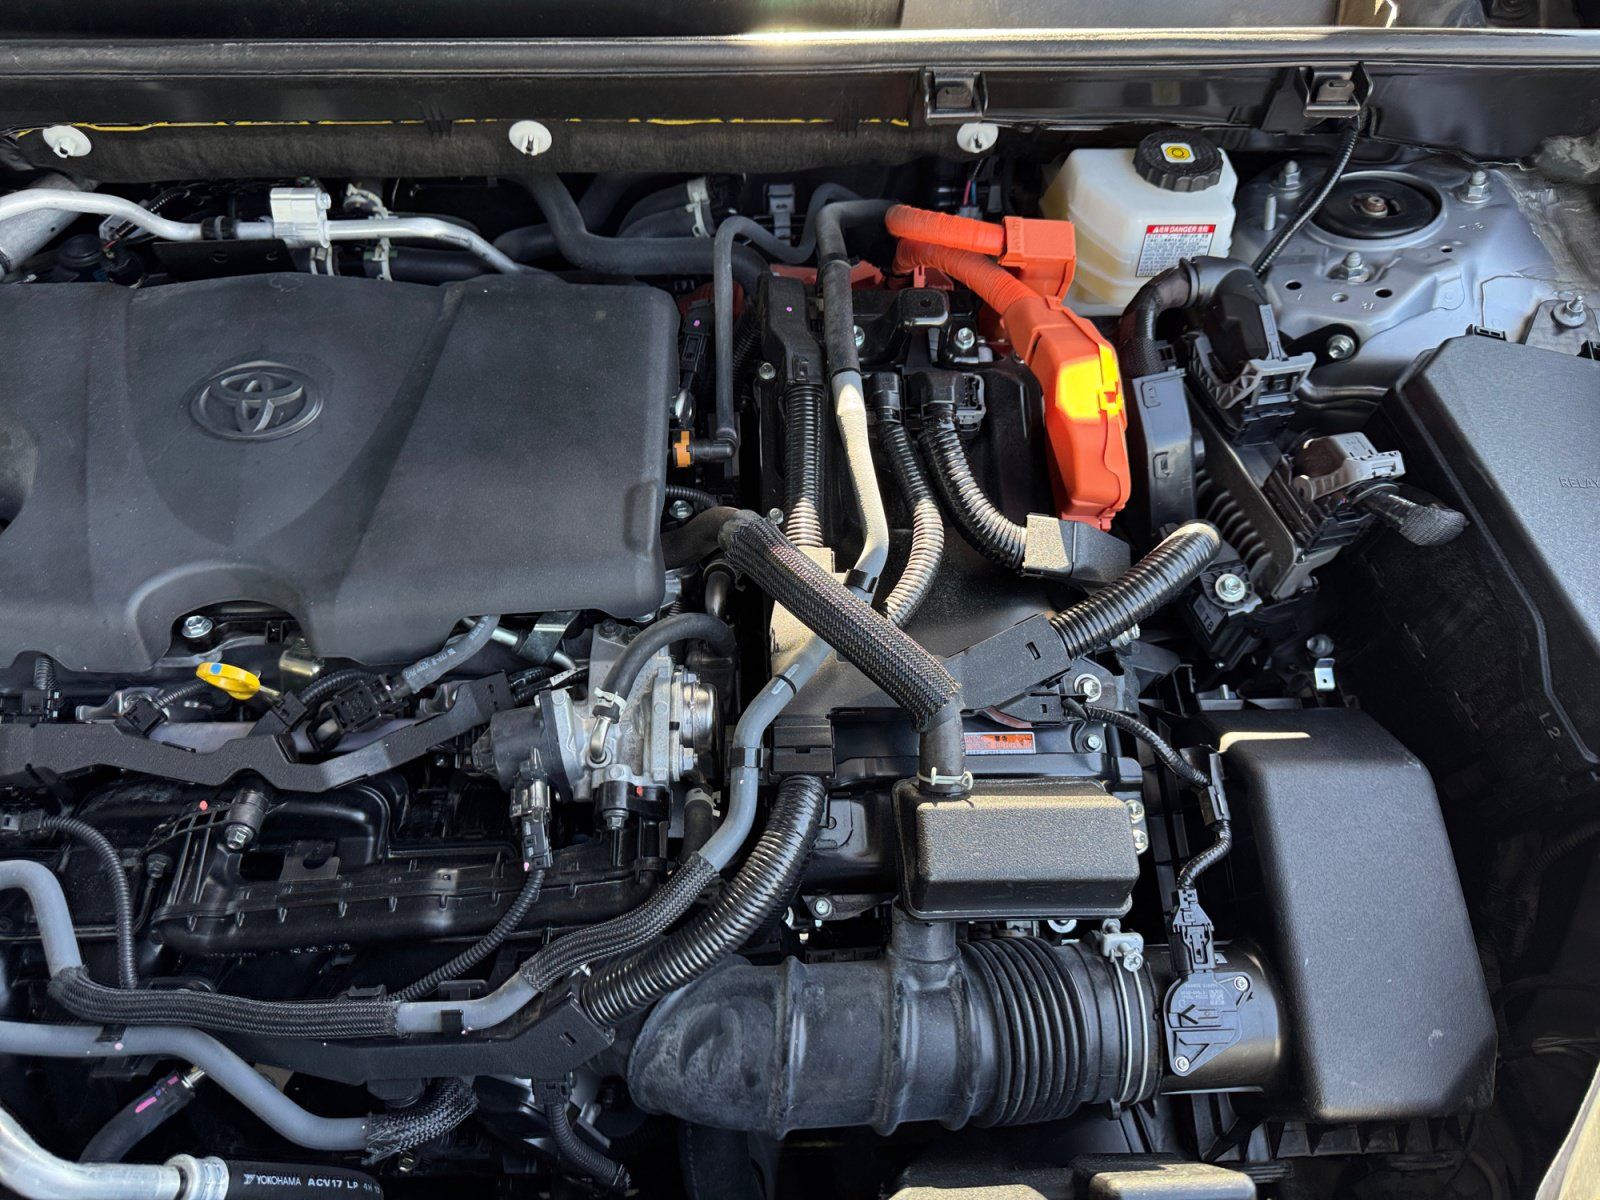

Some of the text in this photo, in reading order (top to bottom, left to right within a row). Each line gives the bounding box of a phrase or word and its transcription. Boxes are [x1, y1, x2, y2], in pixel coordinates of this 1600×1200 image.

[1170, 225, 1196, 233] DANGER
[1204, 613, 1214, 631] T8
[256, 1174, 302, 1186] YOKOHAMA
[307, 1178, 343, 1188] ACV17
[347, 1180, 359, 1189] LP
